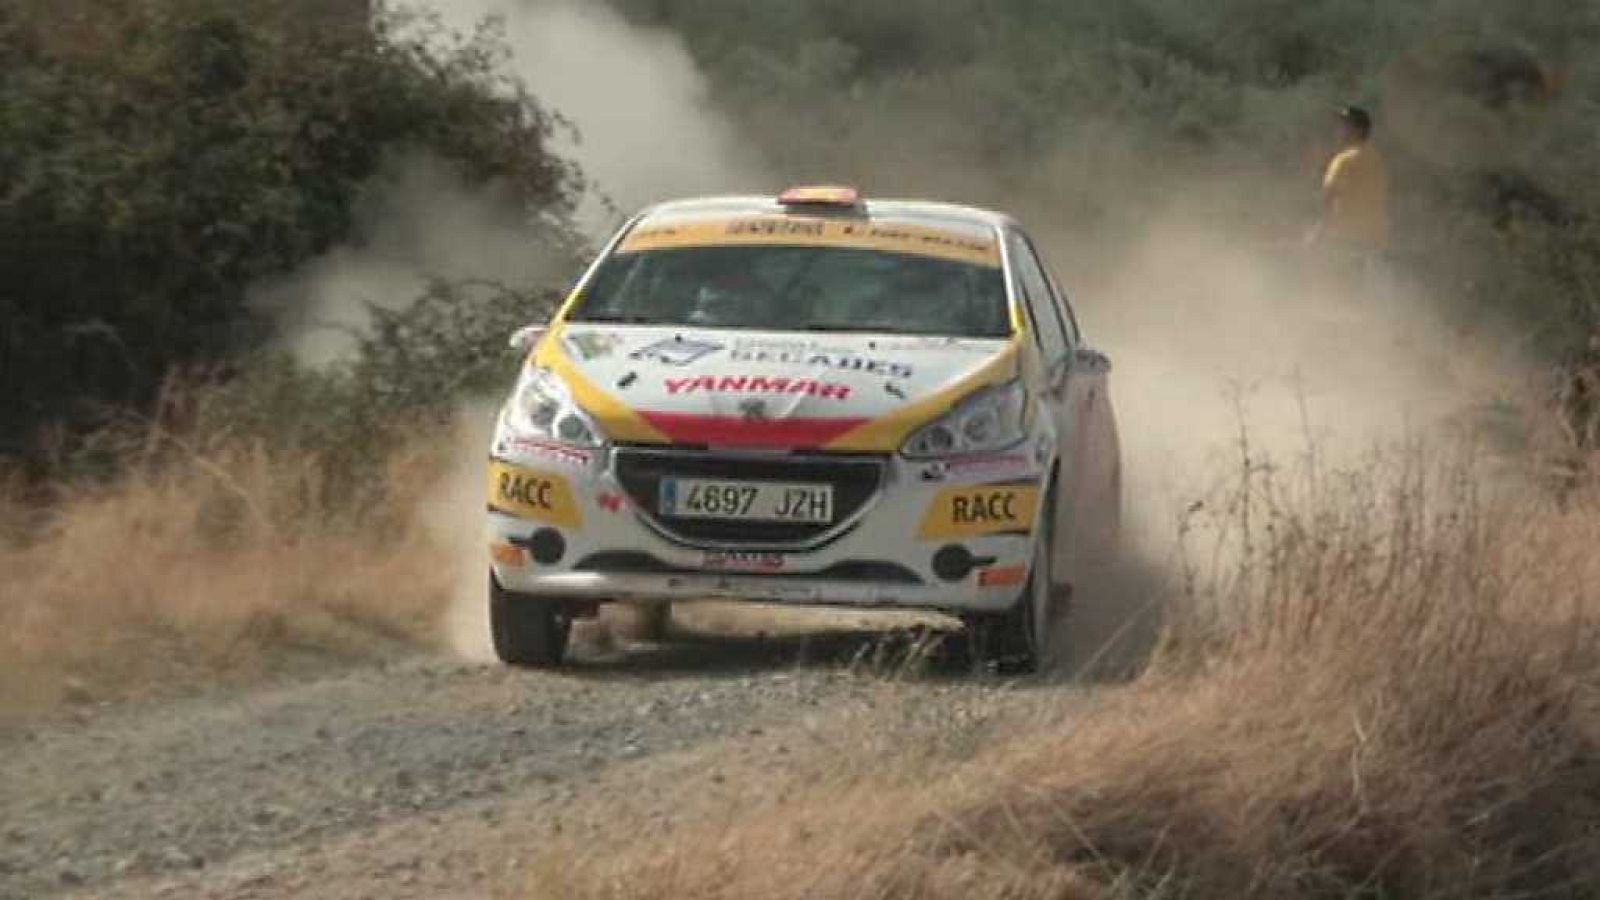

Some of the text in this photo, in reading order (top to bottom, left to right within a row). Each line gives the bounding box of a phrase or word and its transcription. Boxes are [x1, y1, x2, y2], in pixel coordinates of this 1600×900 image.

[664, 375, 852, 402] YANMAR
[499, 471, 553, 510] RACC
[685, 484, 828, 519] 4697 JZH
[951, 490, 1017, 524] RACC
